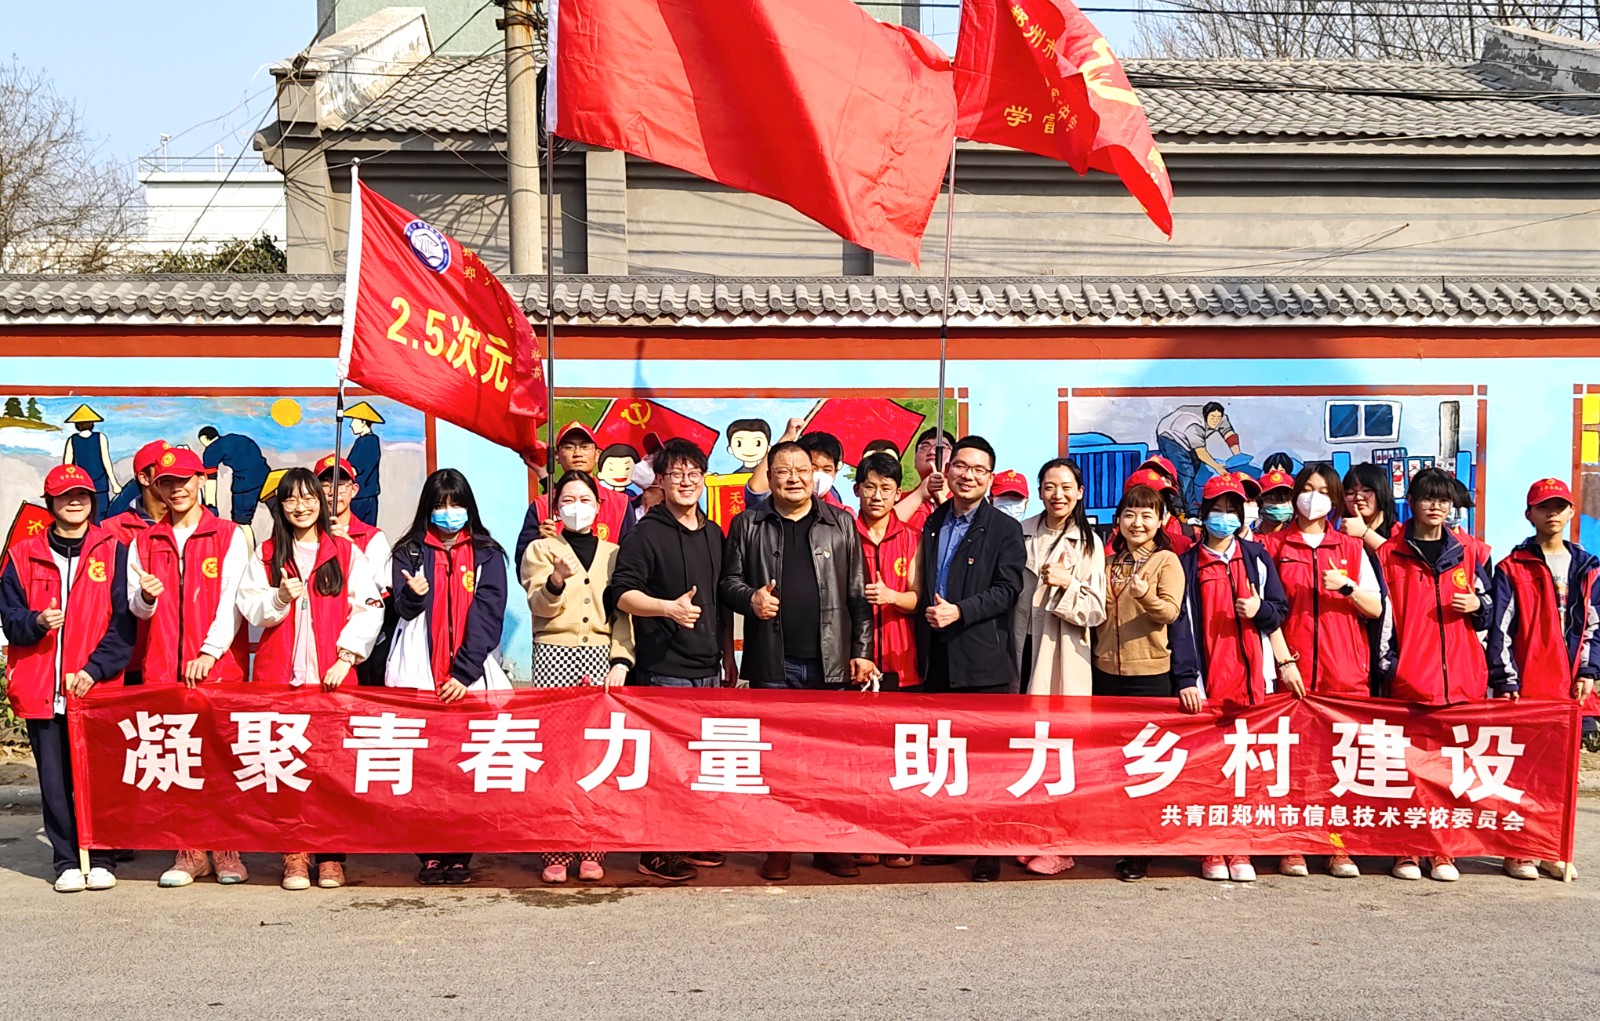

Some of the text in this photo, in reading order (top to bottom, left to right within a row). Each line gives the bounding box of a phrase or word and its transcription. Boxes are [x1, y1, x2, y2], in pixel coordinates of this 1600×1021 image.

[386, 296, 513, 392] 2.5次元
[117, 711, 1529, 804] 凝聚青春力量 助力乡村建设
[1160, 803, 1526, 833] 共青团郑州市信息技术学校委员会
